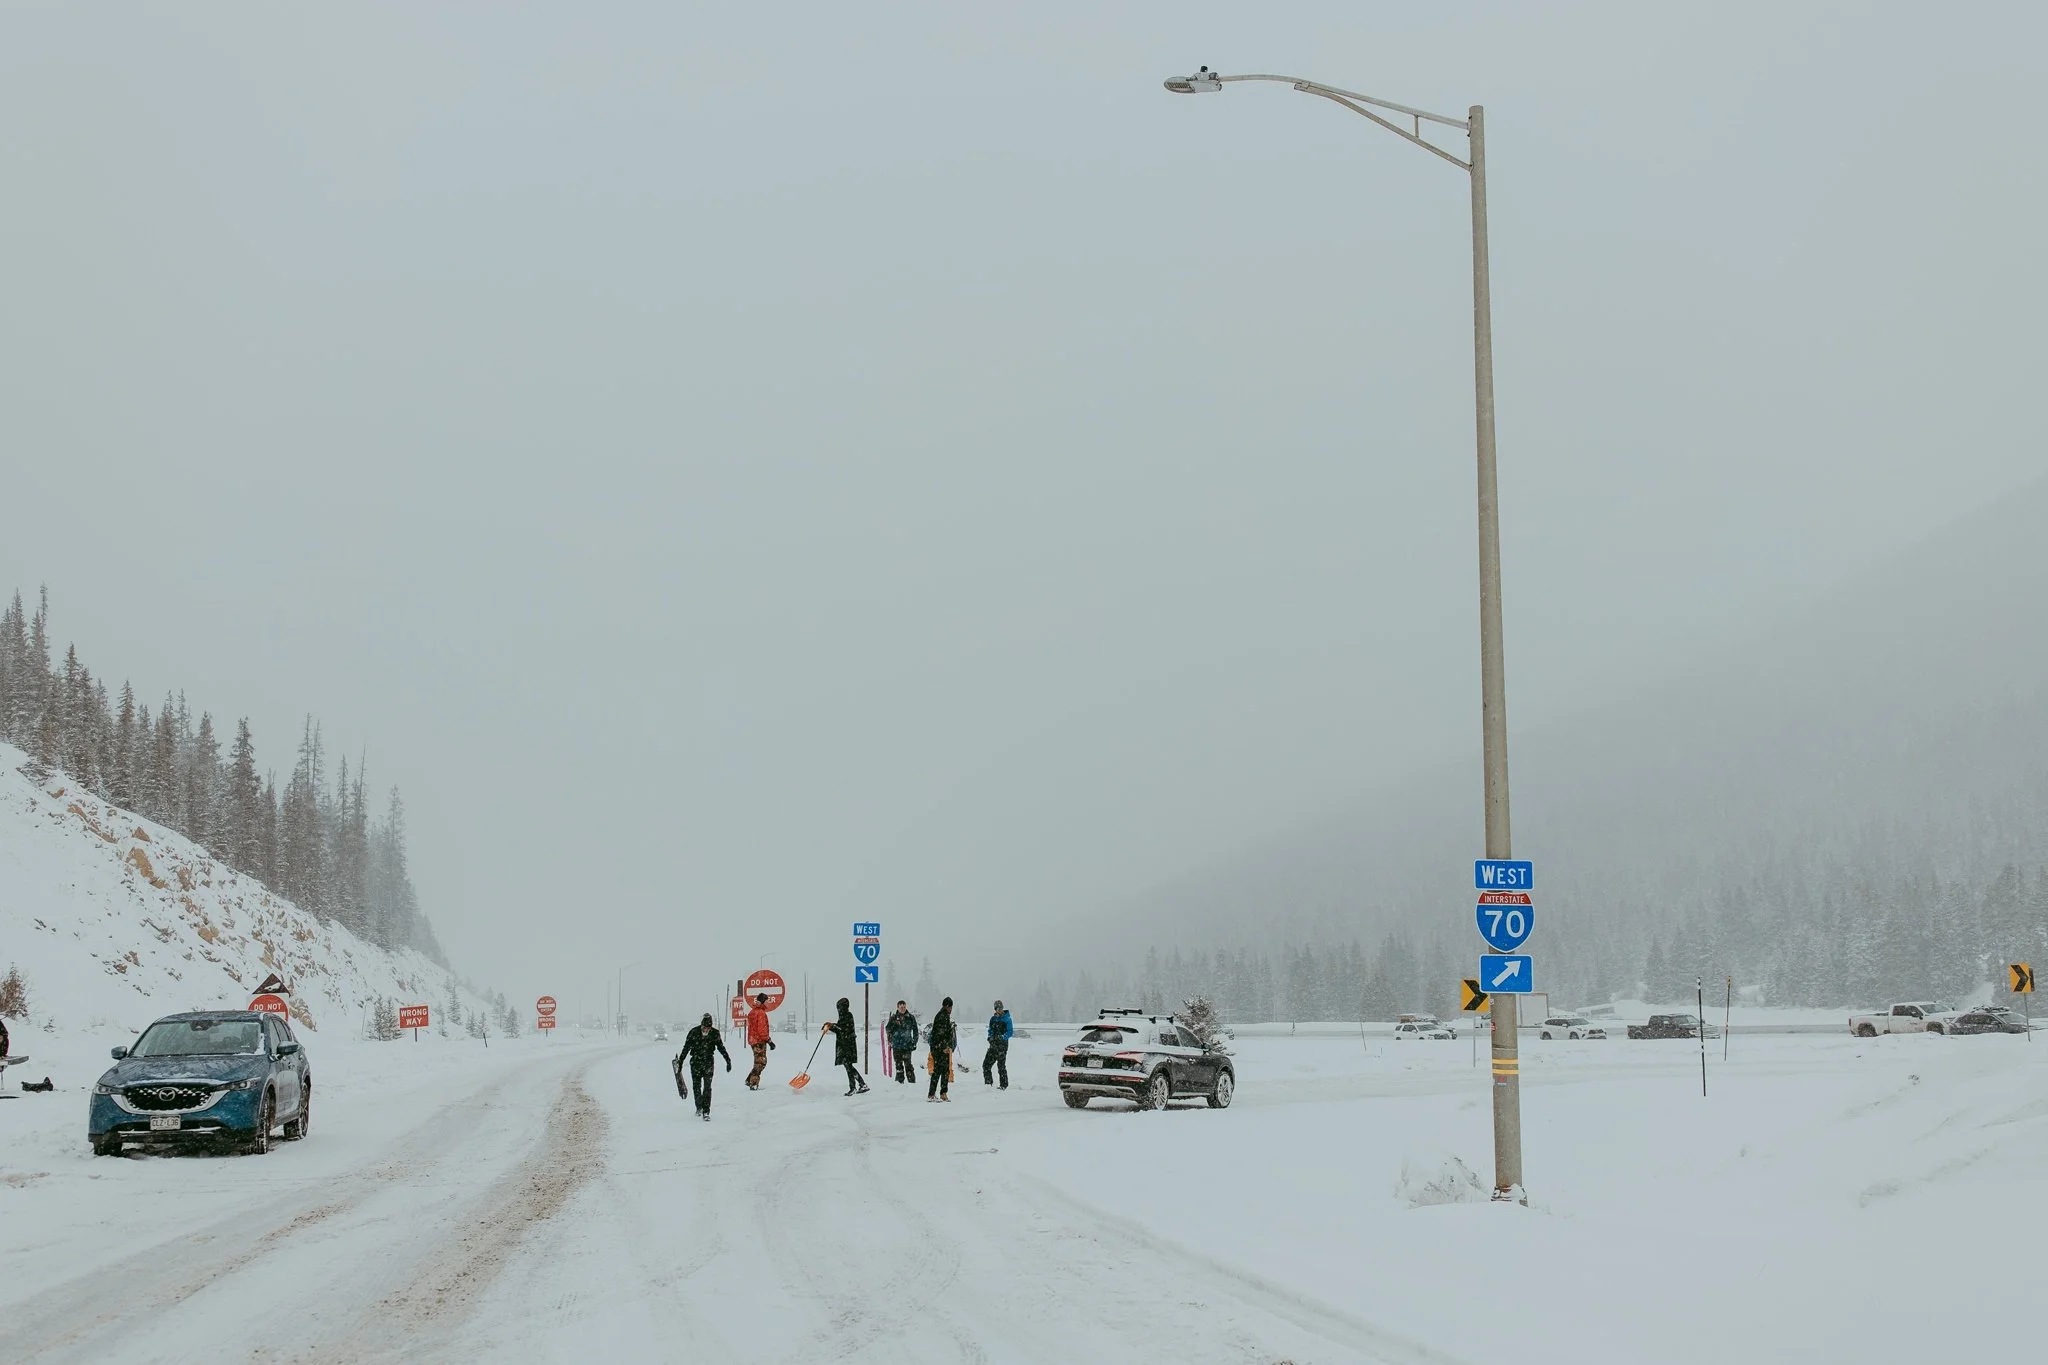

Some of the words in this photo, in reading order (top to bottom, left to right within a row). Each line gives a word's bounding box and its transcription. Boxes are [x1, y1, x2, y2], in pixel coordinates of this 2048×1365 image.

[1481, 865, 1526, 885] WEST
[1484, 895, 1525, 904] INTERSTATE
[1484, 910, 1525, 938] 70
[856, 924, 878, 935] WEST
[857, 945, 876, 959] 70
[753, 996, 776, 1004] EER
[253, 1003, 264, 1011] DO
[400, 1008, 428, 1017] WRONG
[405, 1017, 423, 1026] WAY
